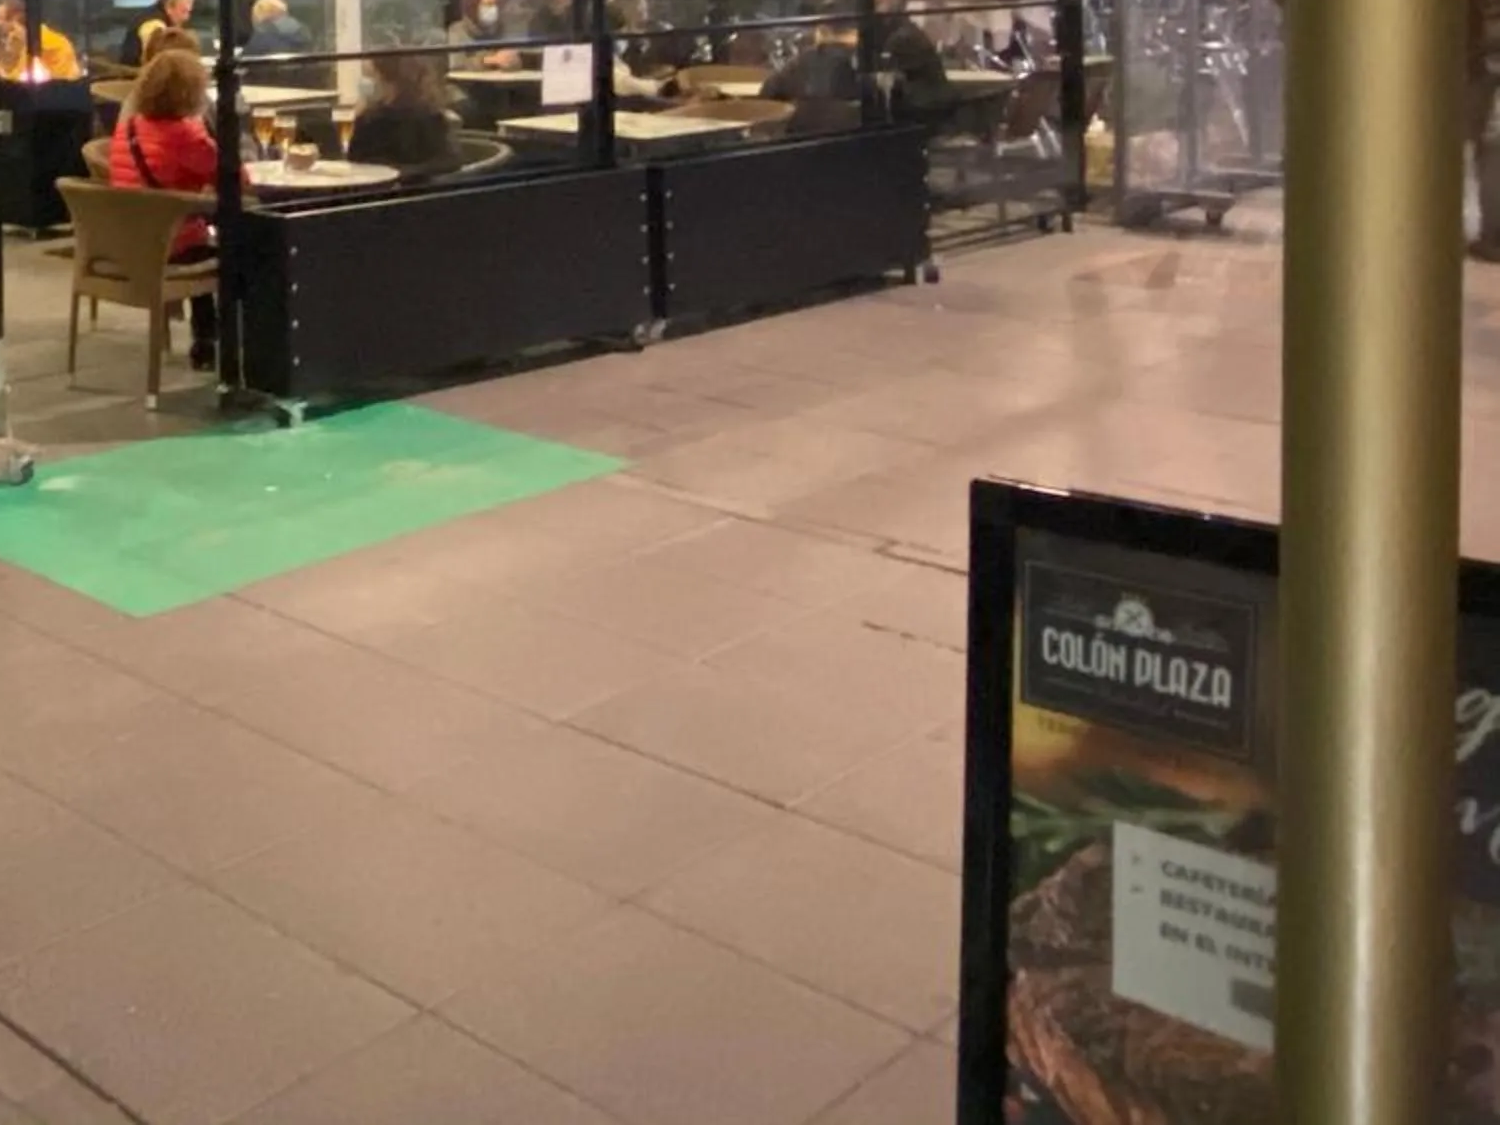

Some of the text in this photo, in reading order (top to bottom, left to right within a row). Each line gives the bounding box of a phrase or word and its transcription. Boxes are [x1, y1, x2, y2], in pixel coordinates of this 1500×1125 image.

[1042, 626, 1128, 684] COLÓN
[1134, 648, 1233, 709] PLAZA
[1160, 887, 1277, 938] RESTAURA
